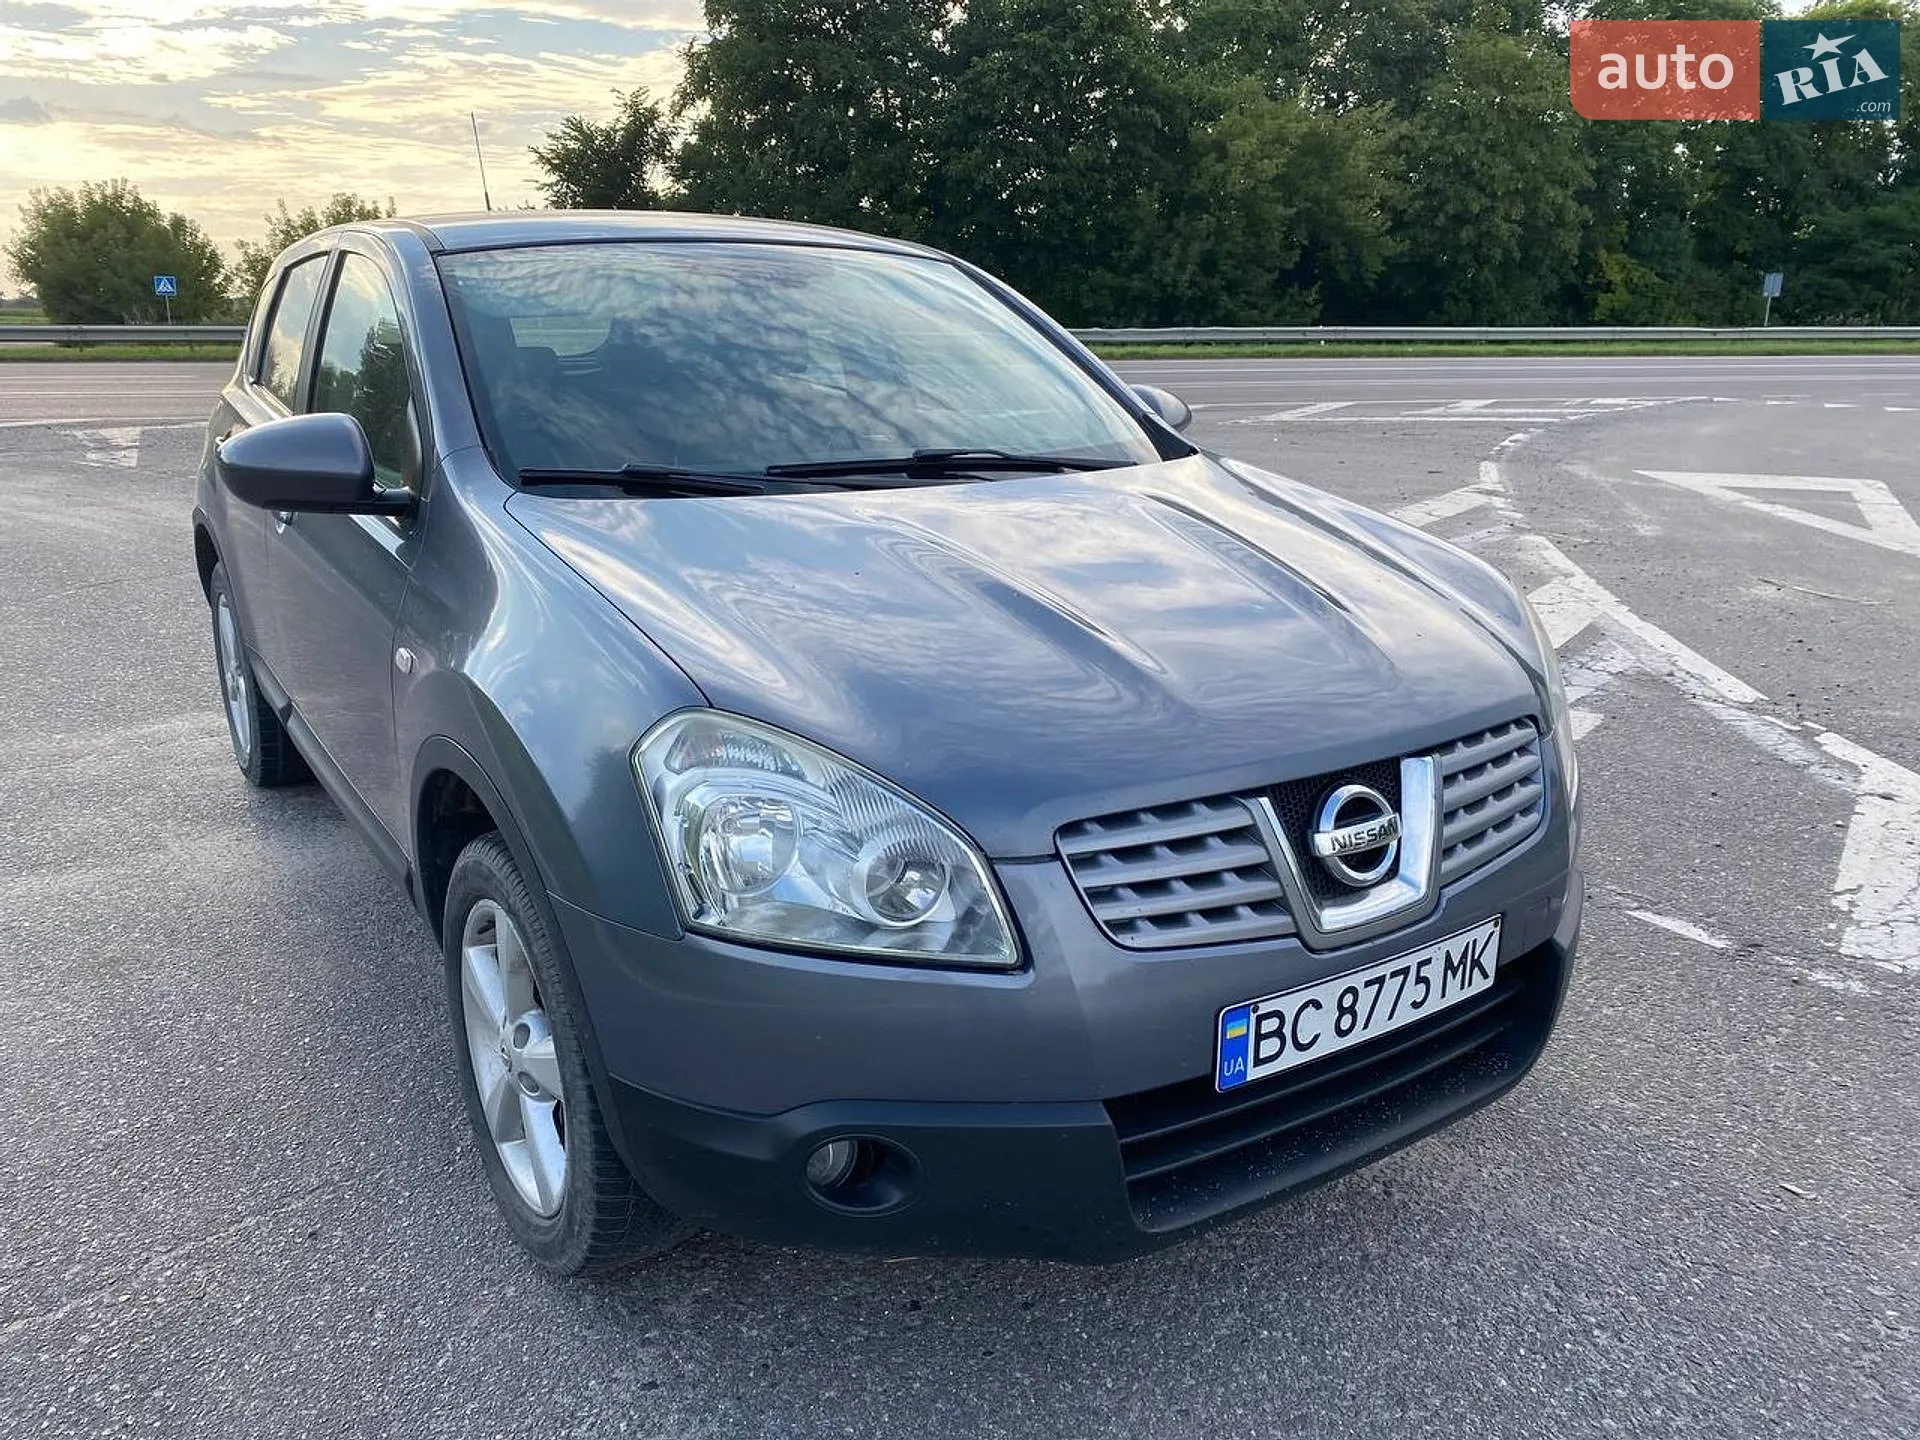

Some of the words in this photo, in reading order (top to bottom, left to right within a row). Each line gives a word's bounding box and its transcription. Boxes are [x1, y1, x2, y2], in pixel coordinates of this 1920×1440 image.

[1330, 816, 1398, 851] NISSAN
[1252, 998, 1323, 1069] BC
[1334, 957, 1433, 1038] 8775
[1440, 930, 1494, 999] MK
[1223, 1056, 1245, 1077] UA
